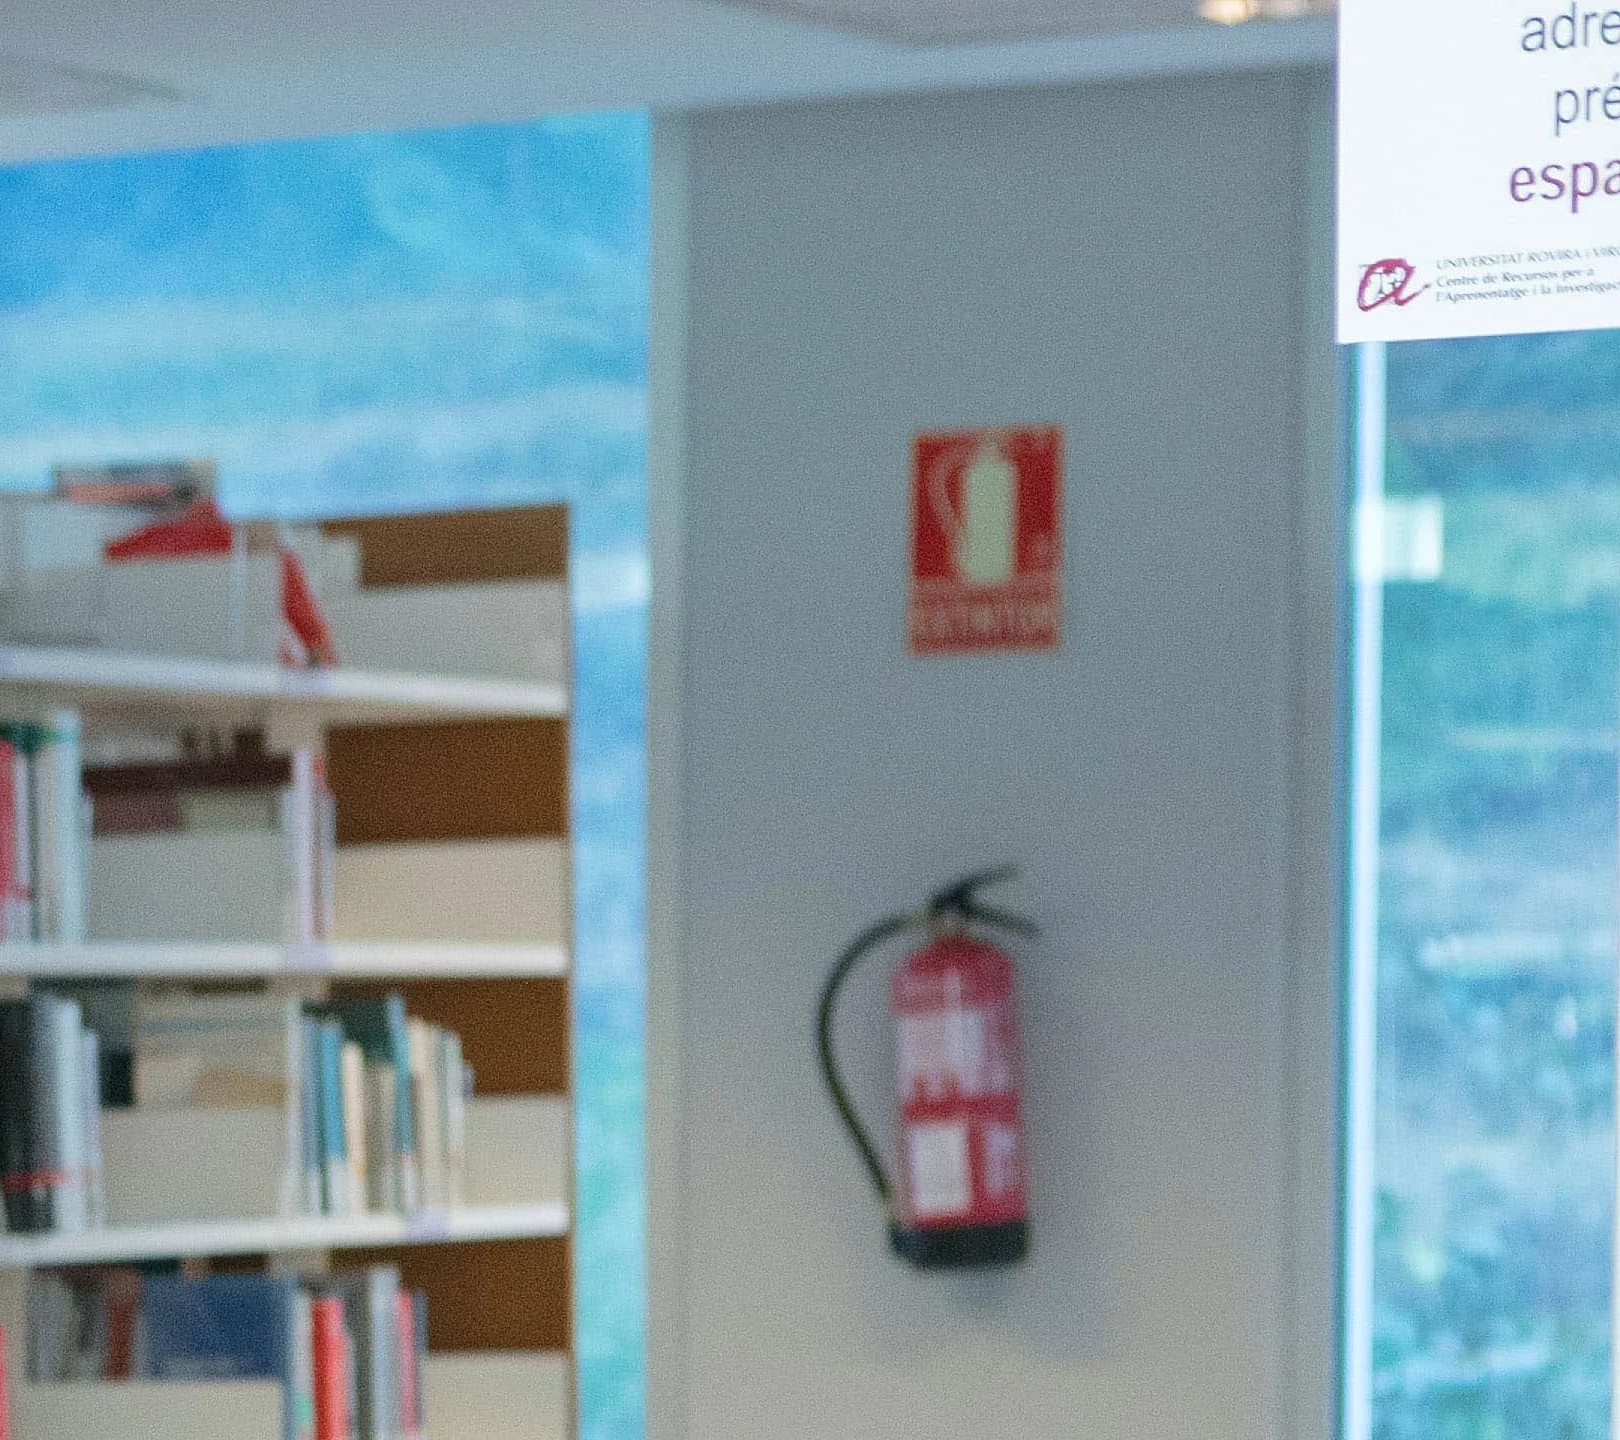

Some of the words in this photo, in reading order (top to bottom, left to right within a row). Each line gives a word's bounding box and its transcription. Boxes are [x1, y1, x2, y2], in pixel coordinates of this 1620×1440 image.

[1521, 1, 1620, 52] adre
[1554, 72, 1620, 137] pré
[1509, 159, 1620, 214] espa
[1436, 253, 1523, 270] UNIVERSITAT
[1528, 249, 1582, 263] ROVIRA
[1436, 275, 1478, 288] Centre
[1483, 271, 1498, 284] de
[1502, 270, 1558, 283] Recursos
